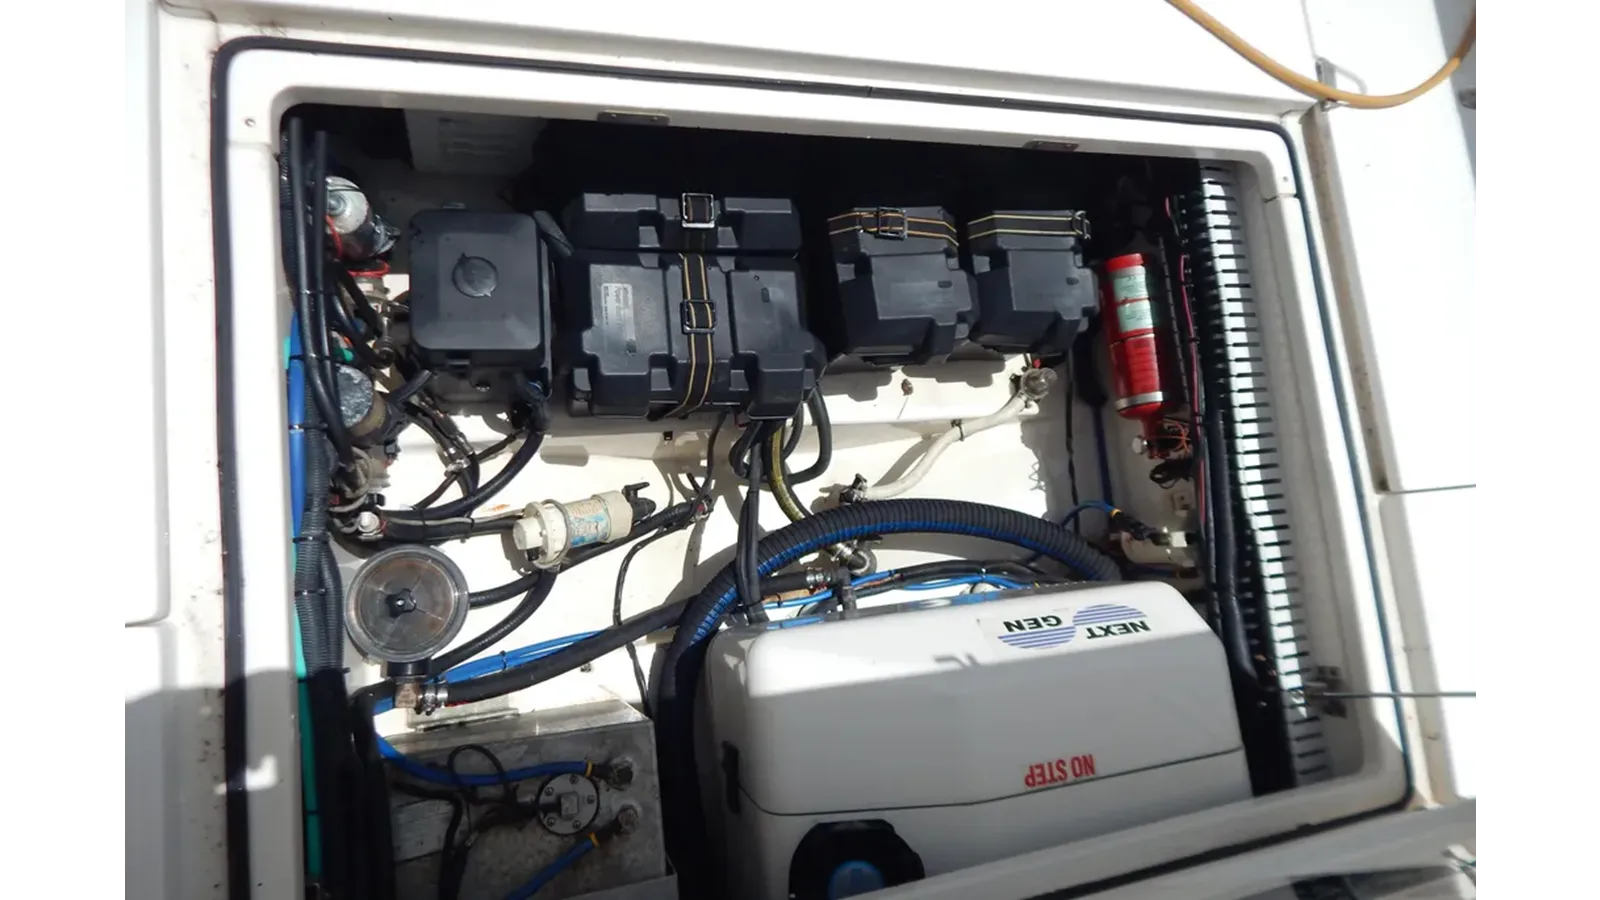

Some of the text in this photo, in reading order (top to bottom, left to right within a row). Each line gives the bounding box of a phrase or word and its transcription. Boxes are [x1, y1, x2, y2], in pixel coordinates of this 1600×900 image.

[1003, 615, 1151, 639] NEXT GEN
[1024, 754, 1096, 788] NO STEP
